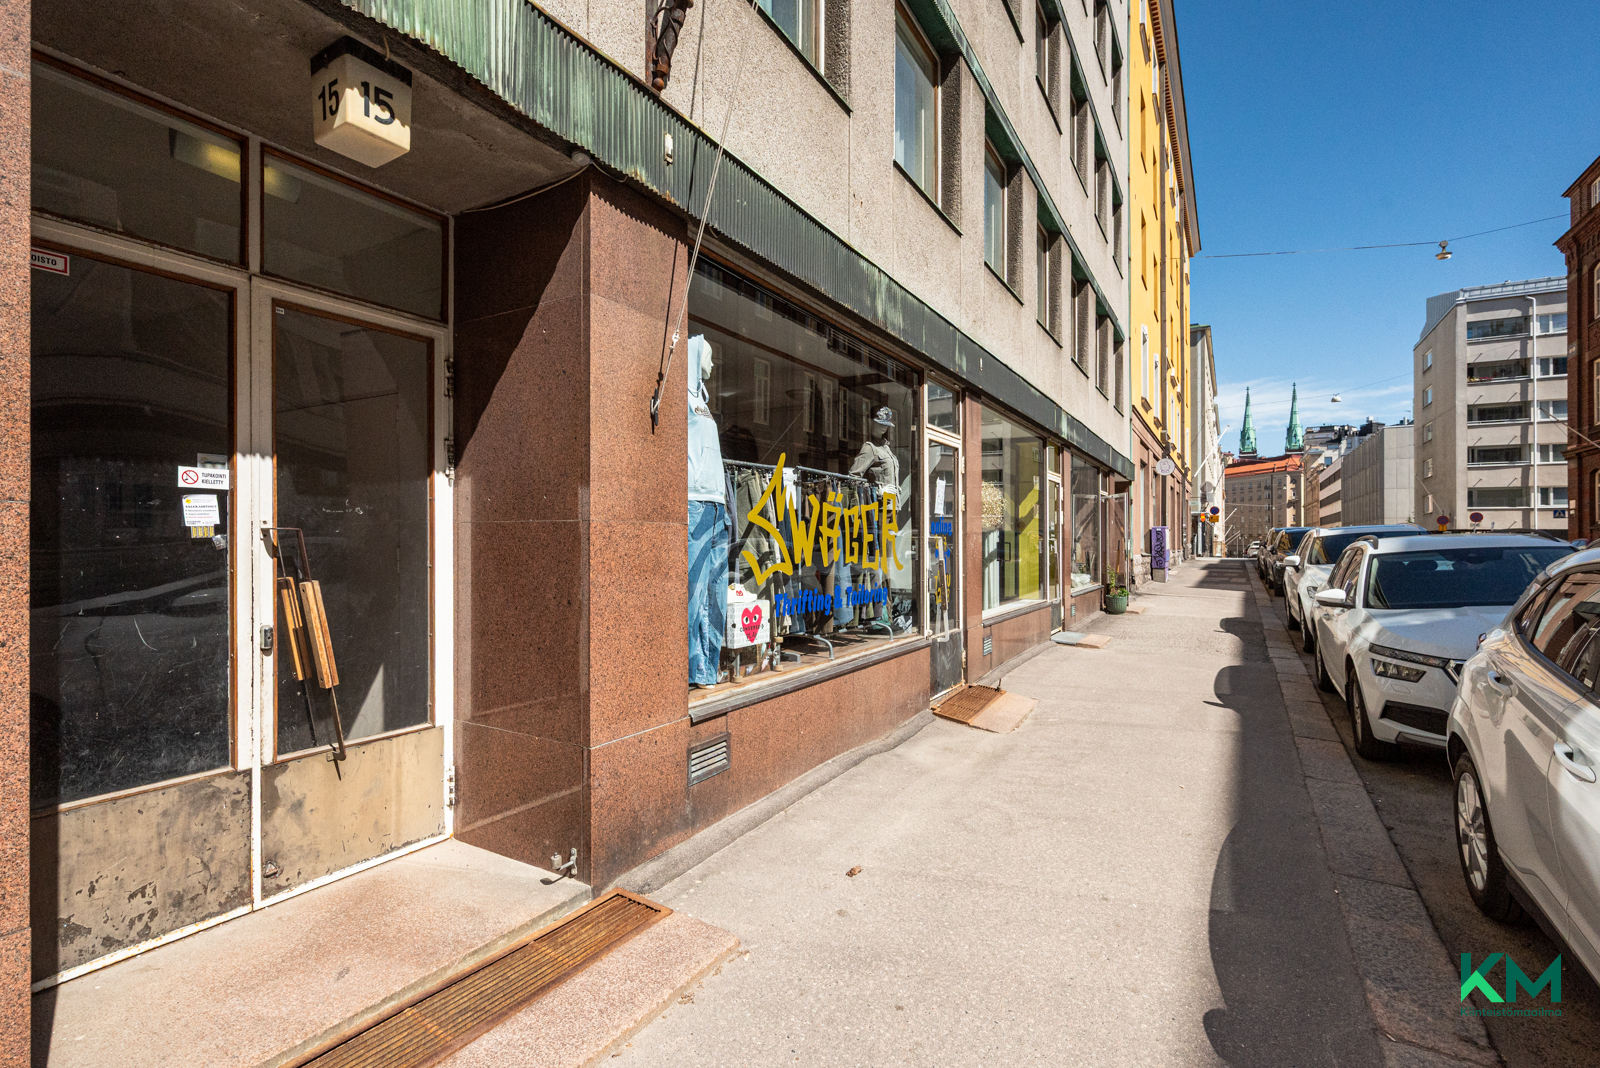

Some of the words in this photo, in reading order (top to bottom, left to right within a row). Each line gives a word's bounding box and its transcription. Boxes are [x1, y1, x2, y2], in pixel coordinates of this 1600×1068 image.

[318, 78, 339, 121] 15
[361, 81, 395, 125] 15
[775, 587, 832, 618] Thrifting
[834, 585, 843, 609] &
[846, 582, 888, 606] Tailoring
